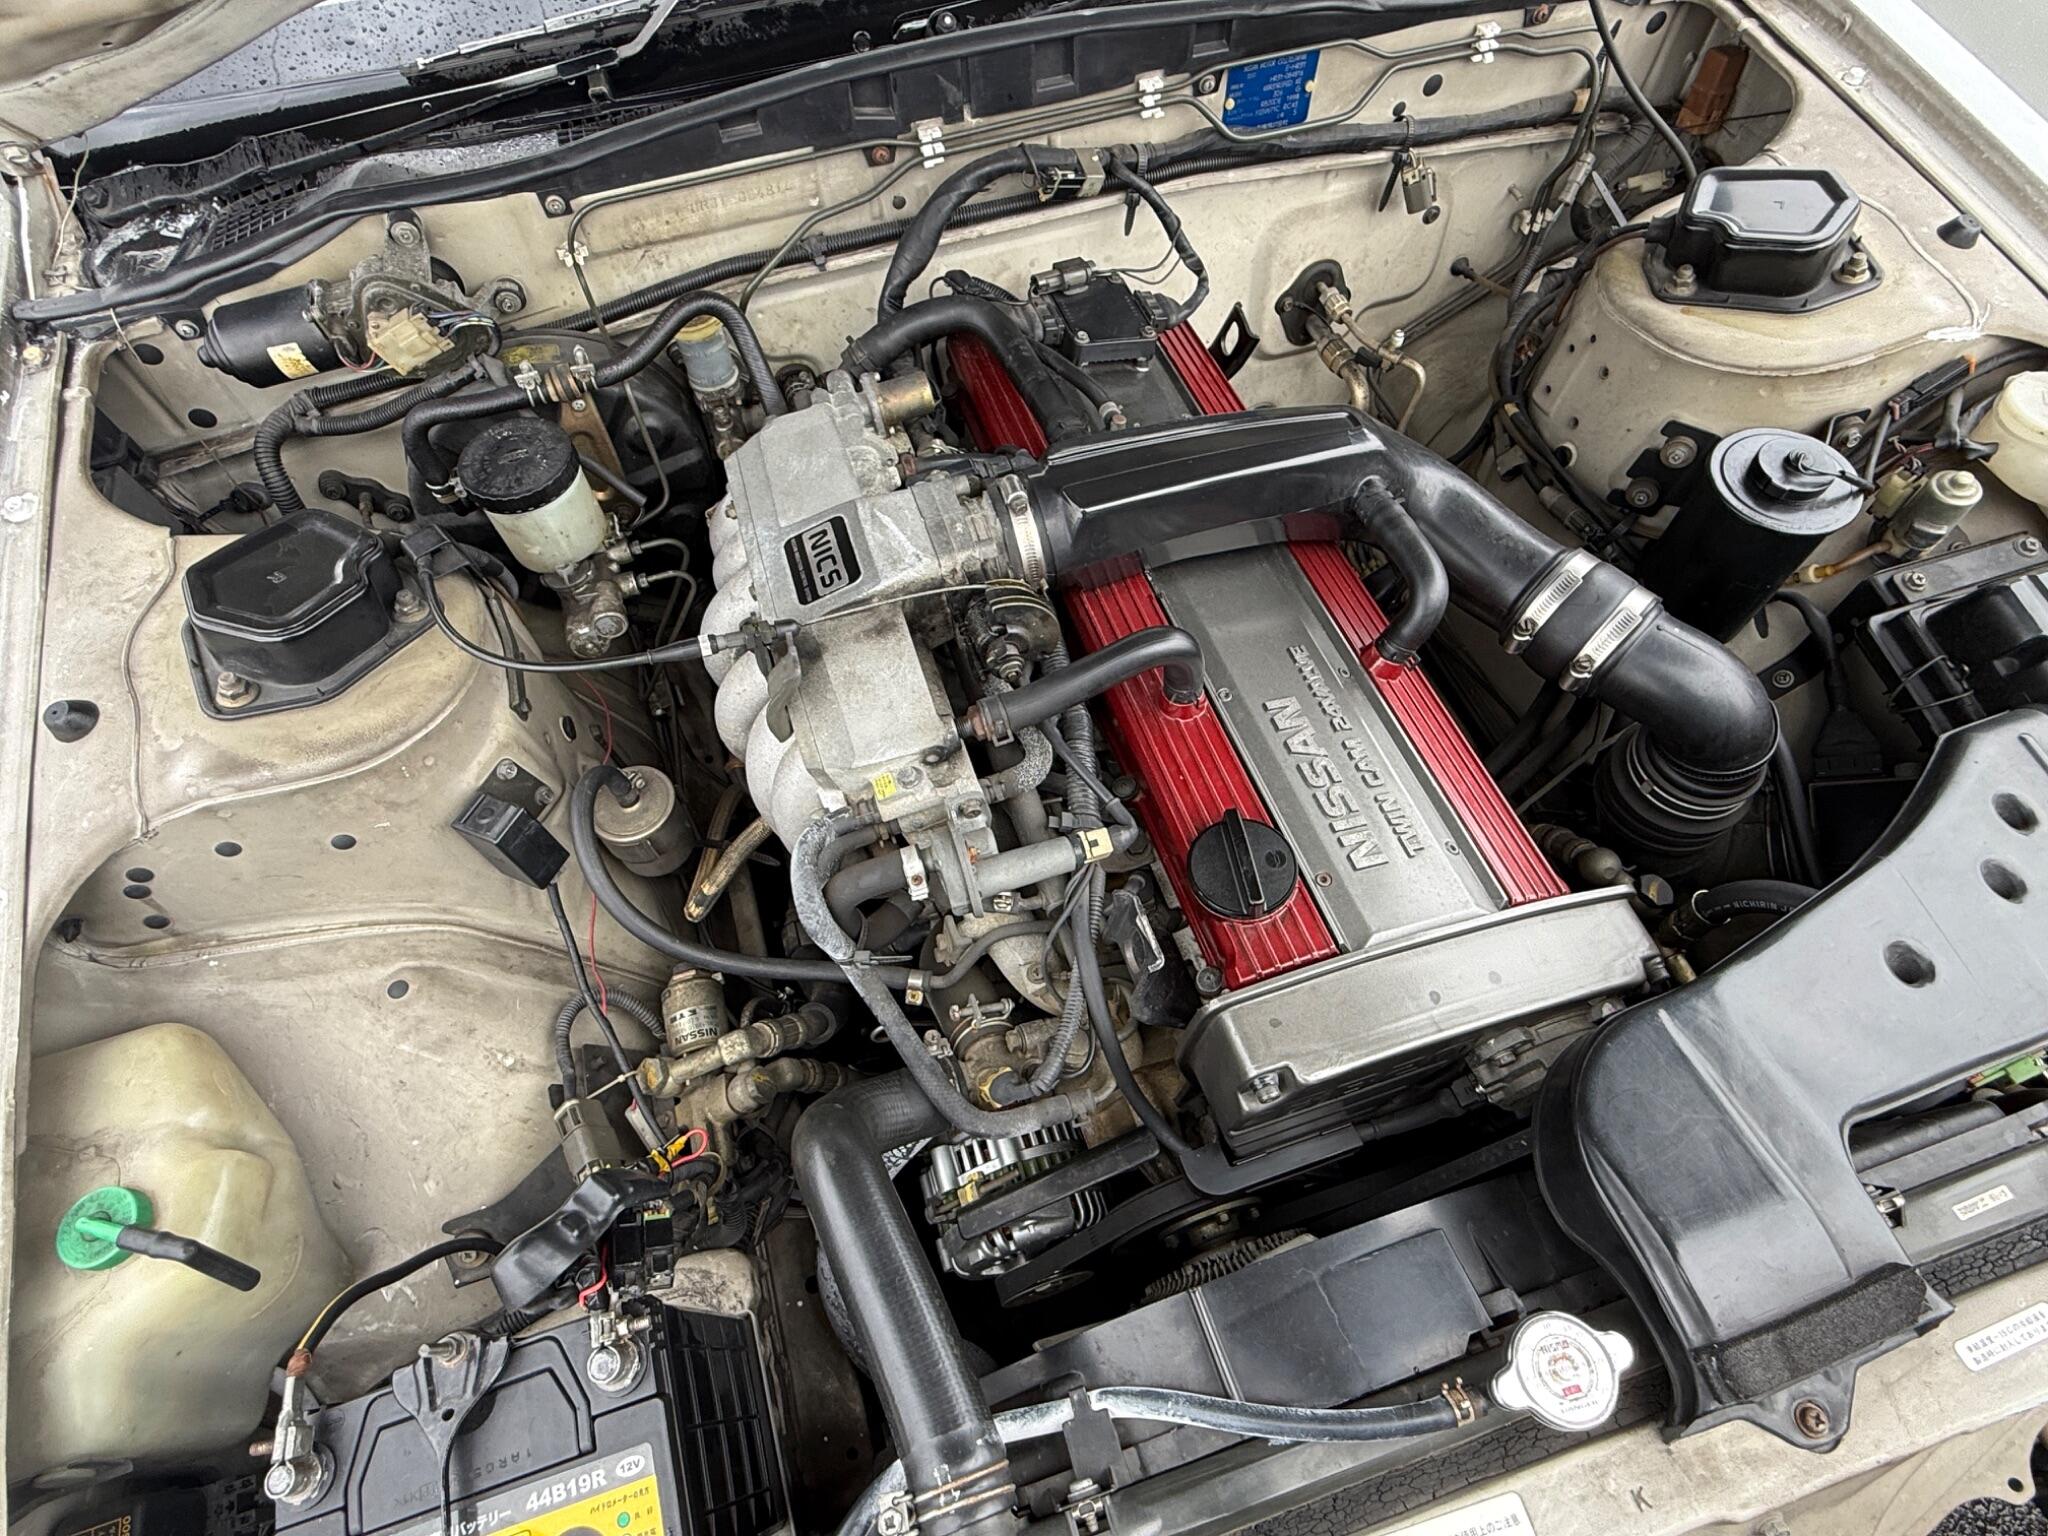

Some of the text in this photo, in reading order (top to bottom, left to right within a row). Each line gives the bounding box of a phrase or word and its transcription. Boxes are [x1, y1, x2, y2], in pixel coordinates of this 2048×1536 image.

[808, 528, 842, 588] NICS
[1263, 696, 1389, 872] NISSAN
[1341, 736, 1385, 789] CAM
[1374, 791, 1425, 859] TWIN
[675, 1027, 718, 1045] NISSAN
[525, 1458, 642, 1513] 44B19R 12V
